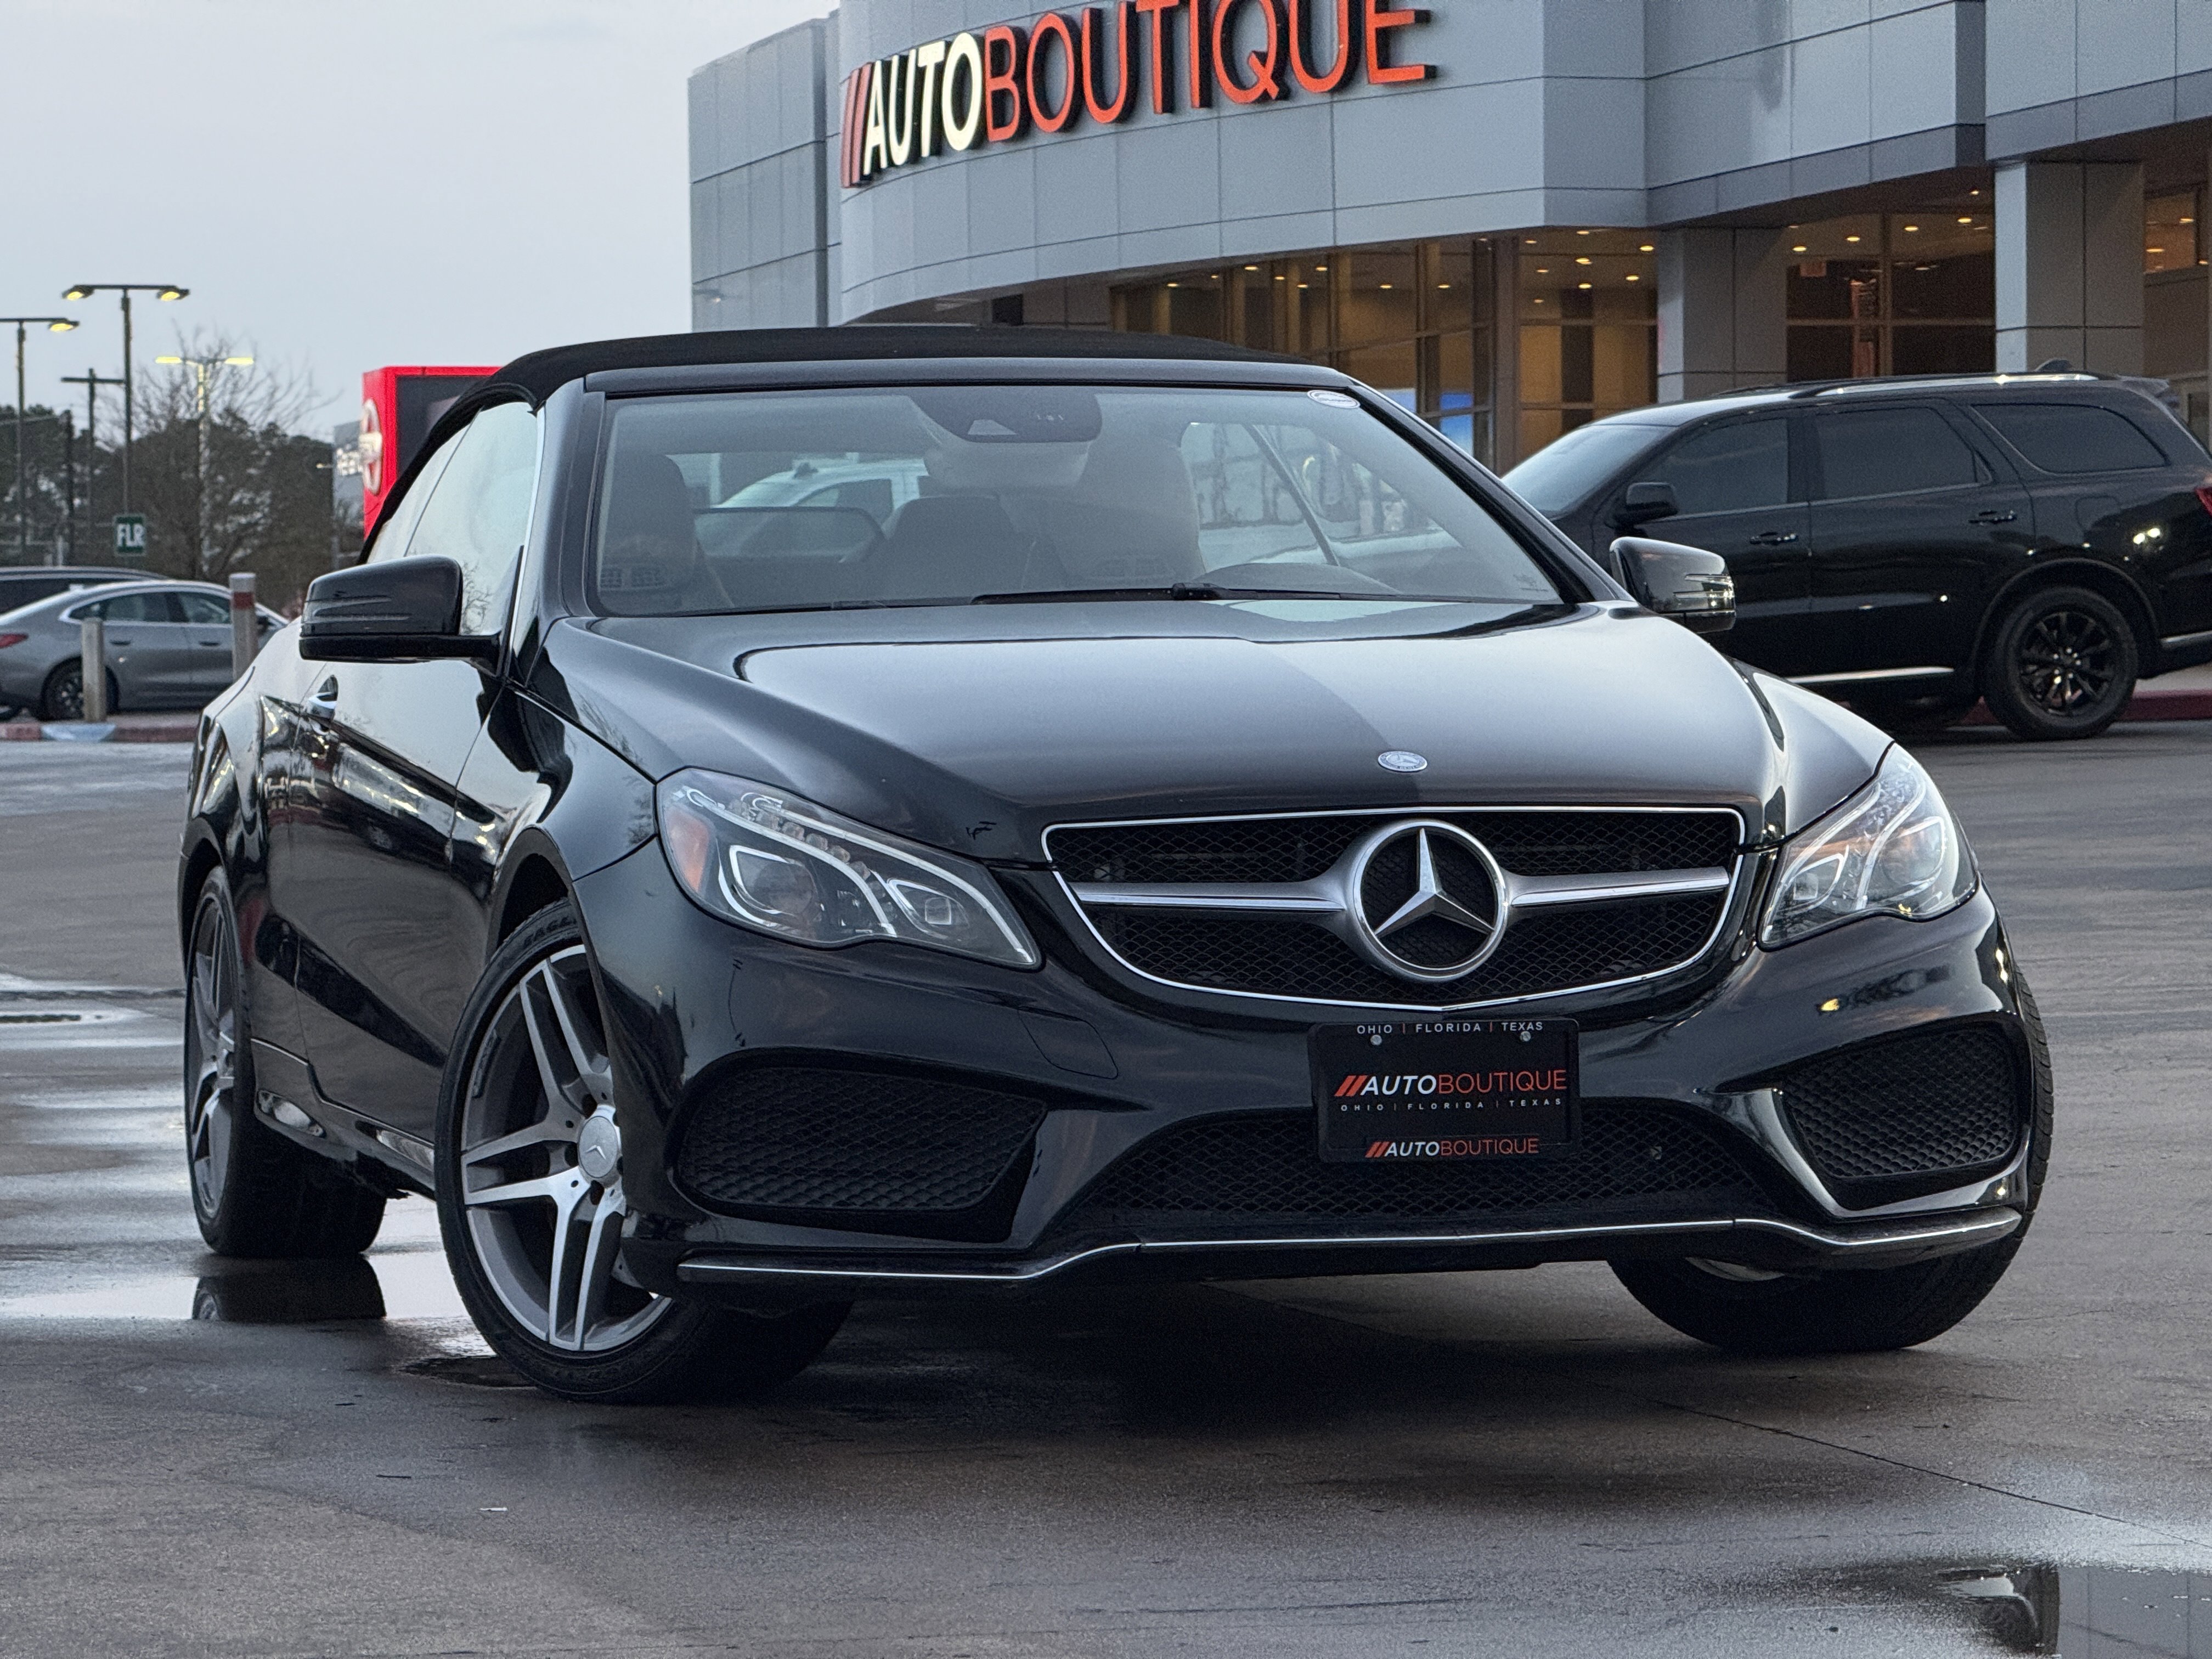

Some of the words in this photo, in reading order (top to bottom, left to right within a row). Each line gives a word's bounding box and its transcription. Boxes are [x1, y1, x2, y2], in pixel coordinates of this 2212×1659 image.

[863, 0, 1425, 175] AUTOBOUTIQUE
[1357, 1024, 1392, 1034] OHIO
[1416, 1023, 1481, 1033] FLORIDA
[1502, 1022, 1543, 1031] TEXAS
[1359, 1070, 1566, 1096] AUTOBOUTIQUE
[1407, 1102, 1483, 1110] FLORIDA
[1509, 1098, 1561, 1107] TEXAS
[1384, 1138, 1539, 1157] AUTOBOUTIQUE
